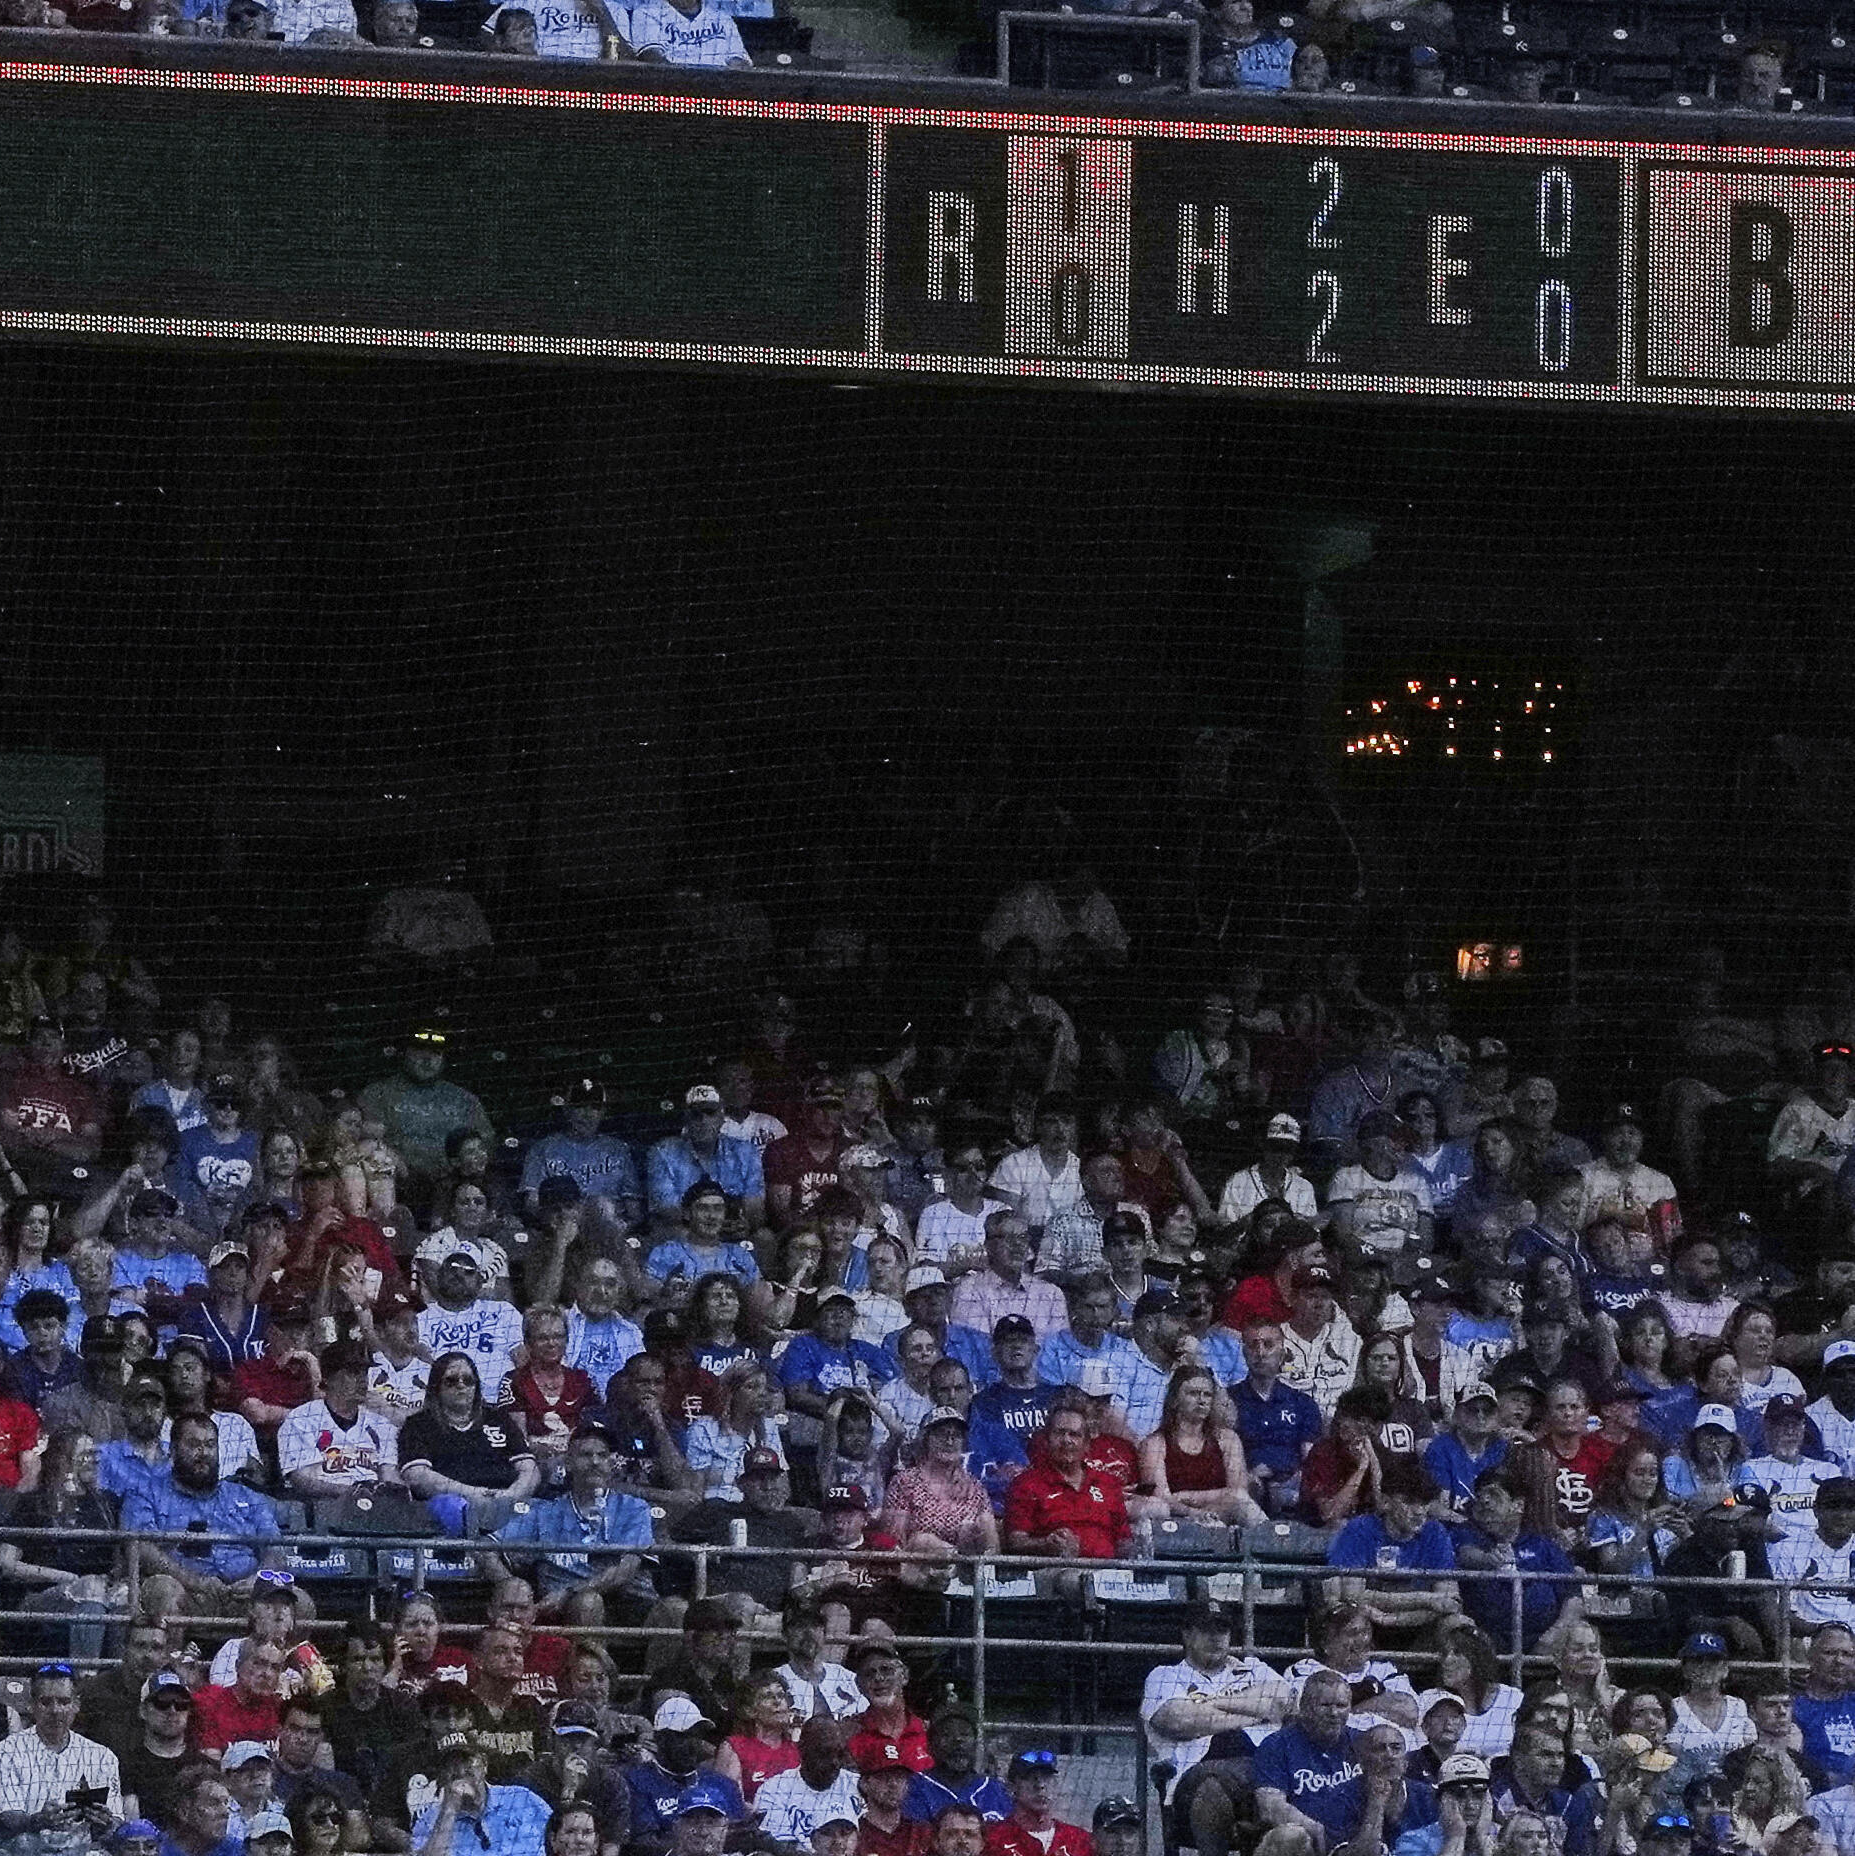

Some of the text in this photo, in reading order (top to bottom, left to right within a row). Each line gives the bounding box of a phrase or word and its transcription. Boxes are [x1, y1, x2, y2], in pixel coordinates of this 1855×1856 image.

[1054, 147, 1080, 235] 1
[1306, 156, 1344, 250] 2
[1536, 165, 1574, 259] 0
[927, 190, 977, 304] R
[1177, 202, 1230, 315] H
[1427, 214, 1473, 326] E
[1728, 199, 1795, 350] B
[1052, 263, 1089, 349] 0
[1305, 270, 1342, 364] 2
[1536, 278, 1574, 372] 0
[829, 1487, 850, 1498] STL
[1294, 1761, 1363, 1796] Royals
